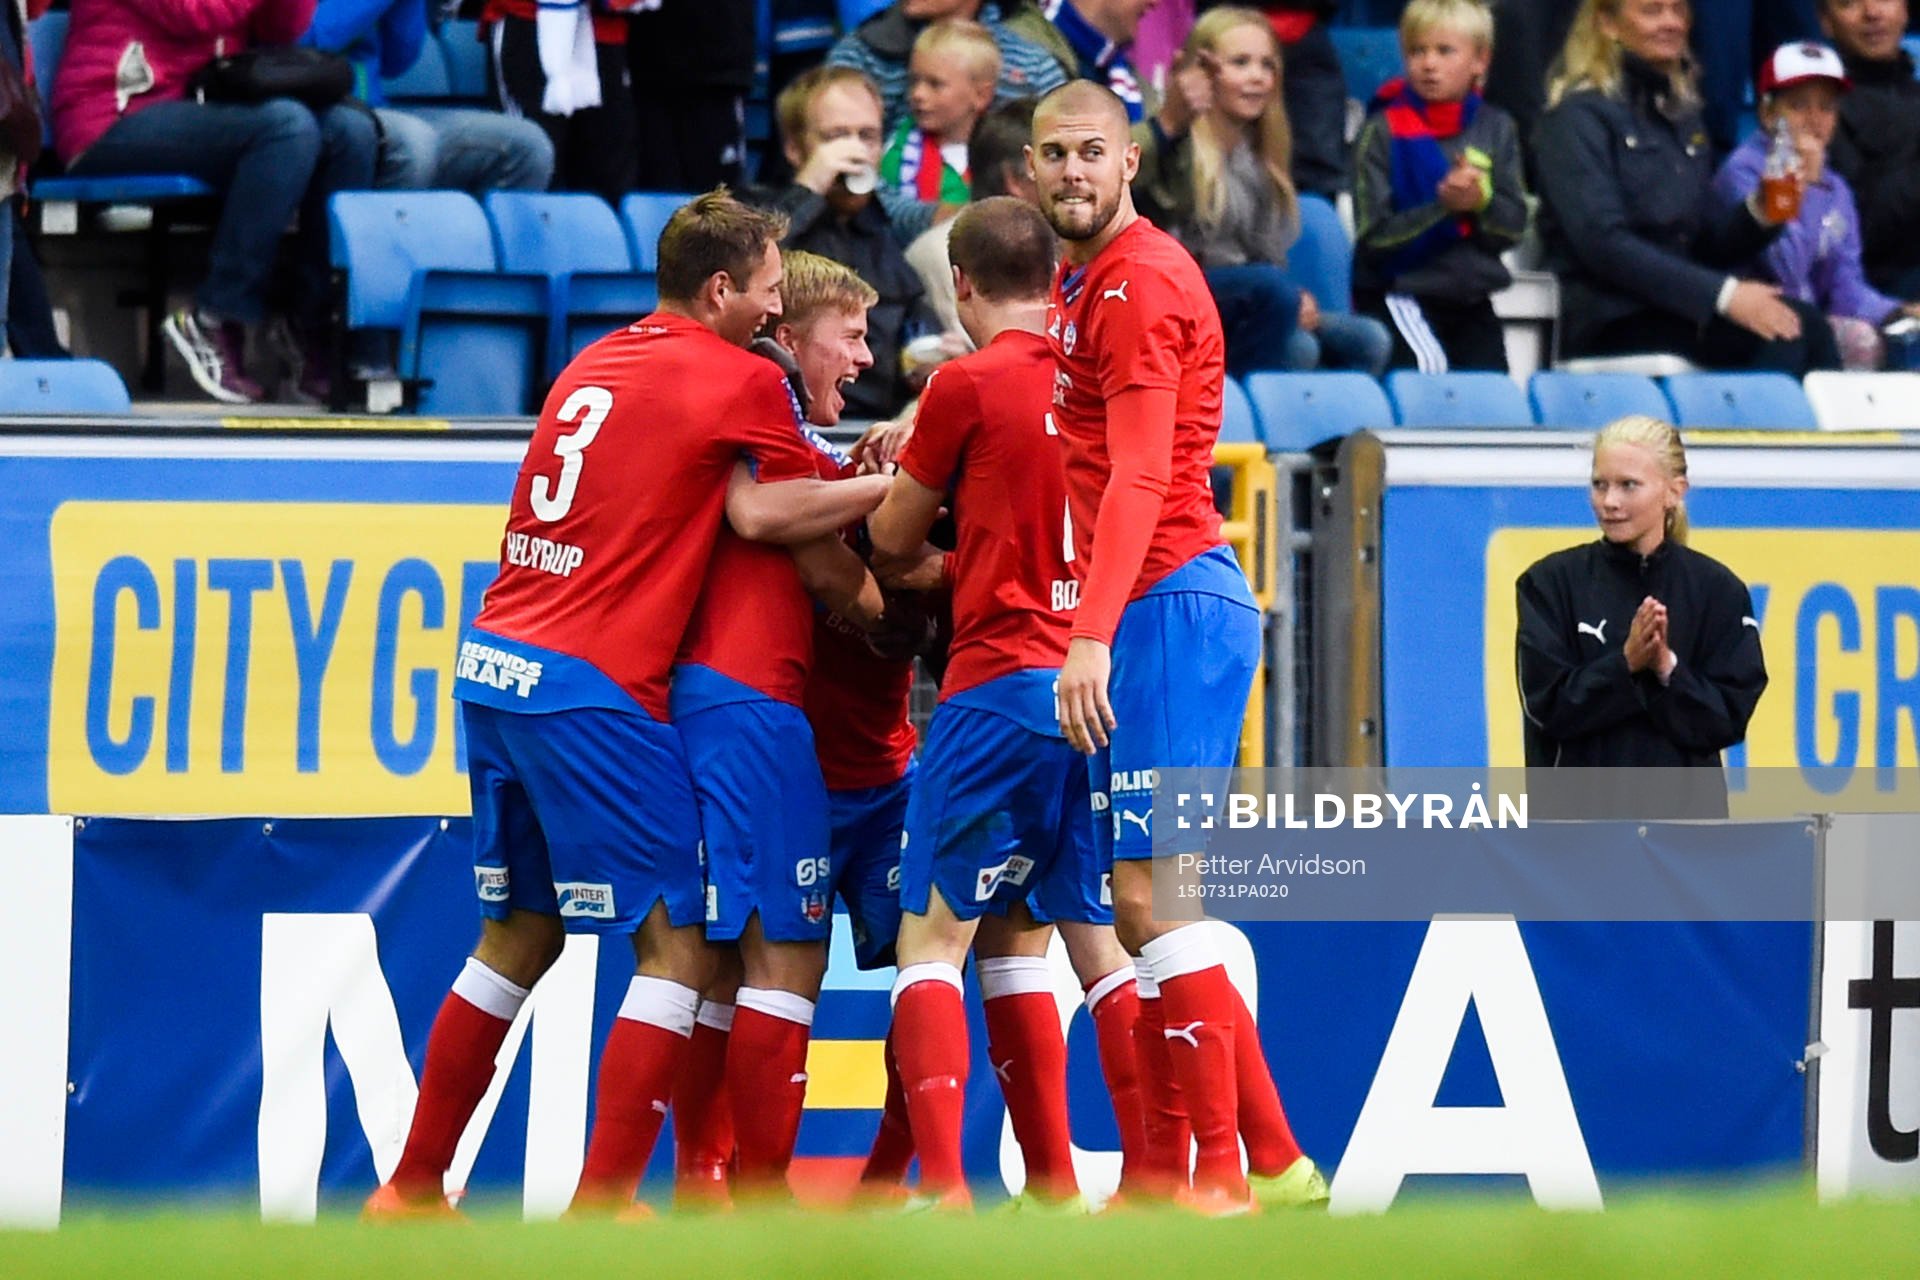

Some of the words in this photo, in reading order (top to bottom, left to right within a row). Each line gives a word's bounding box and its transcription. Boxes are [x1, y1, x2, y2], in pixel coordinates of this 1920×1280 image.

[530, 386, 614, 522] 3
[86, 555, 354, 776] CITY
[461, 641, 543, 678] RESUNDS
[1111, 769, 1161, 793] OLID
[571, 889, 604, 901] INTER
